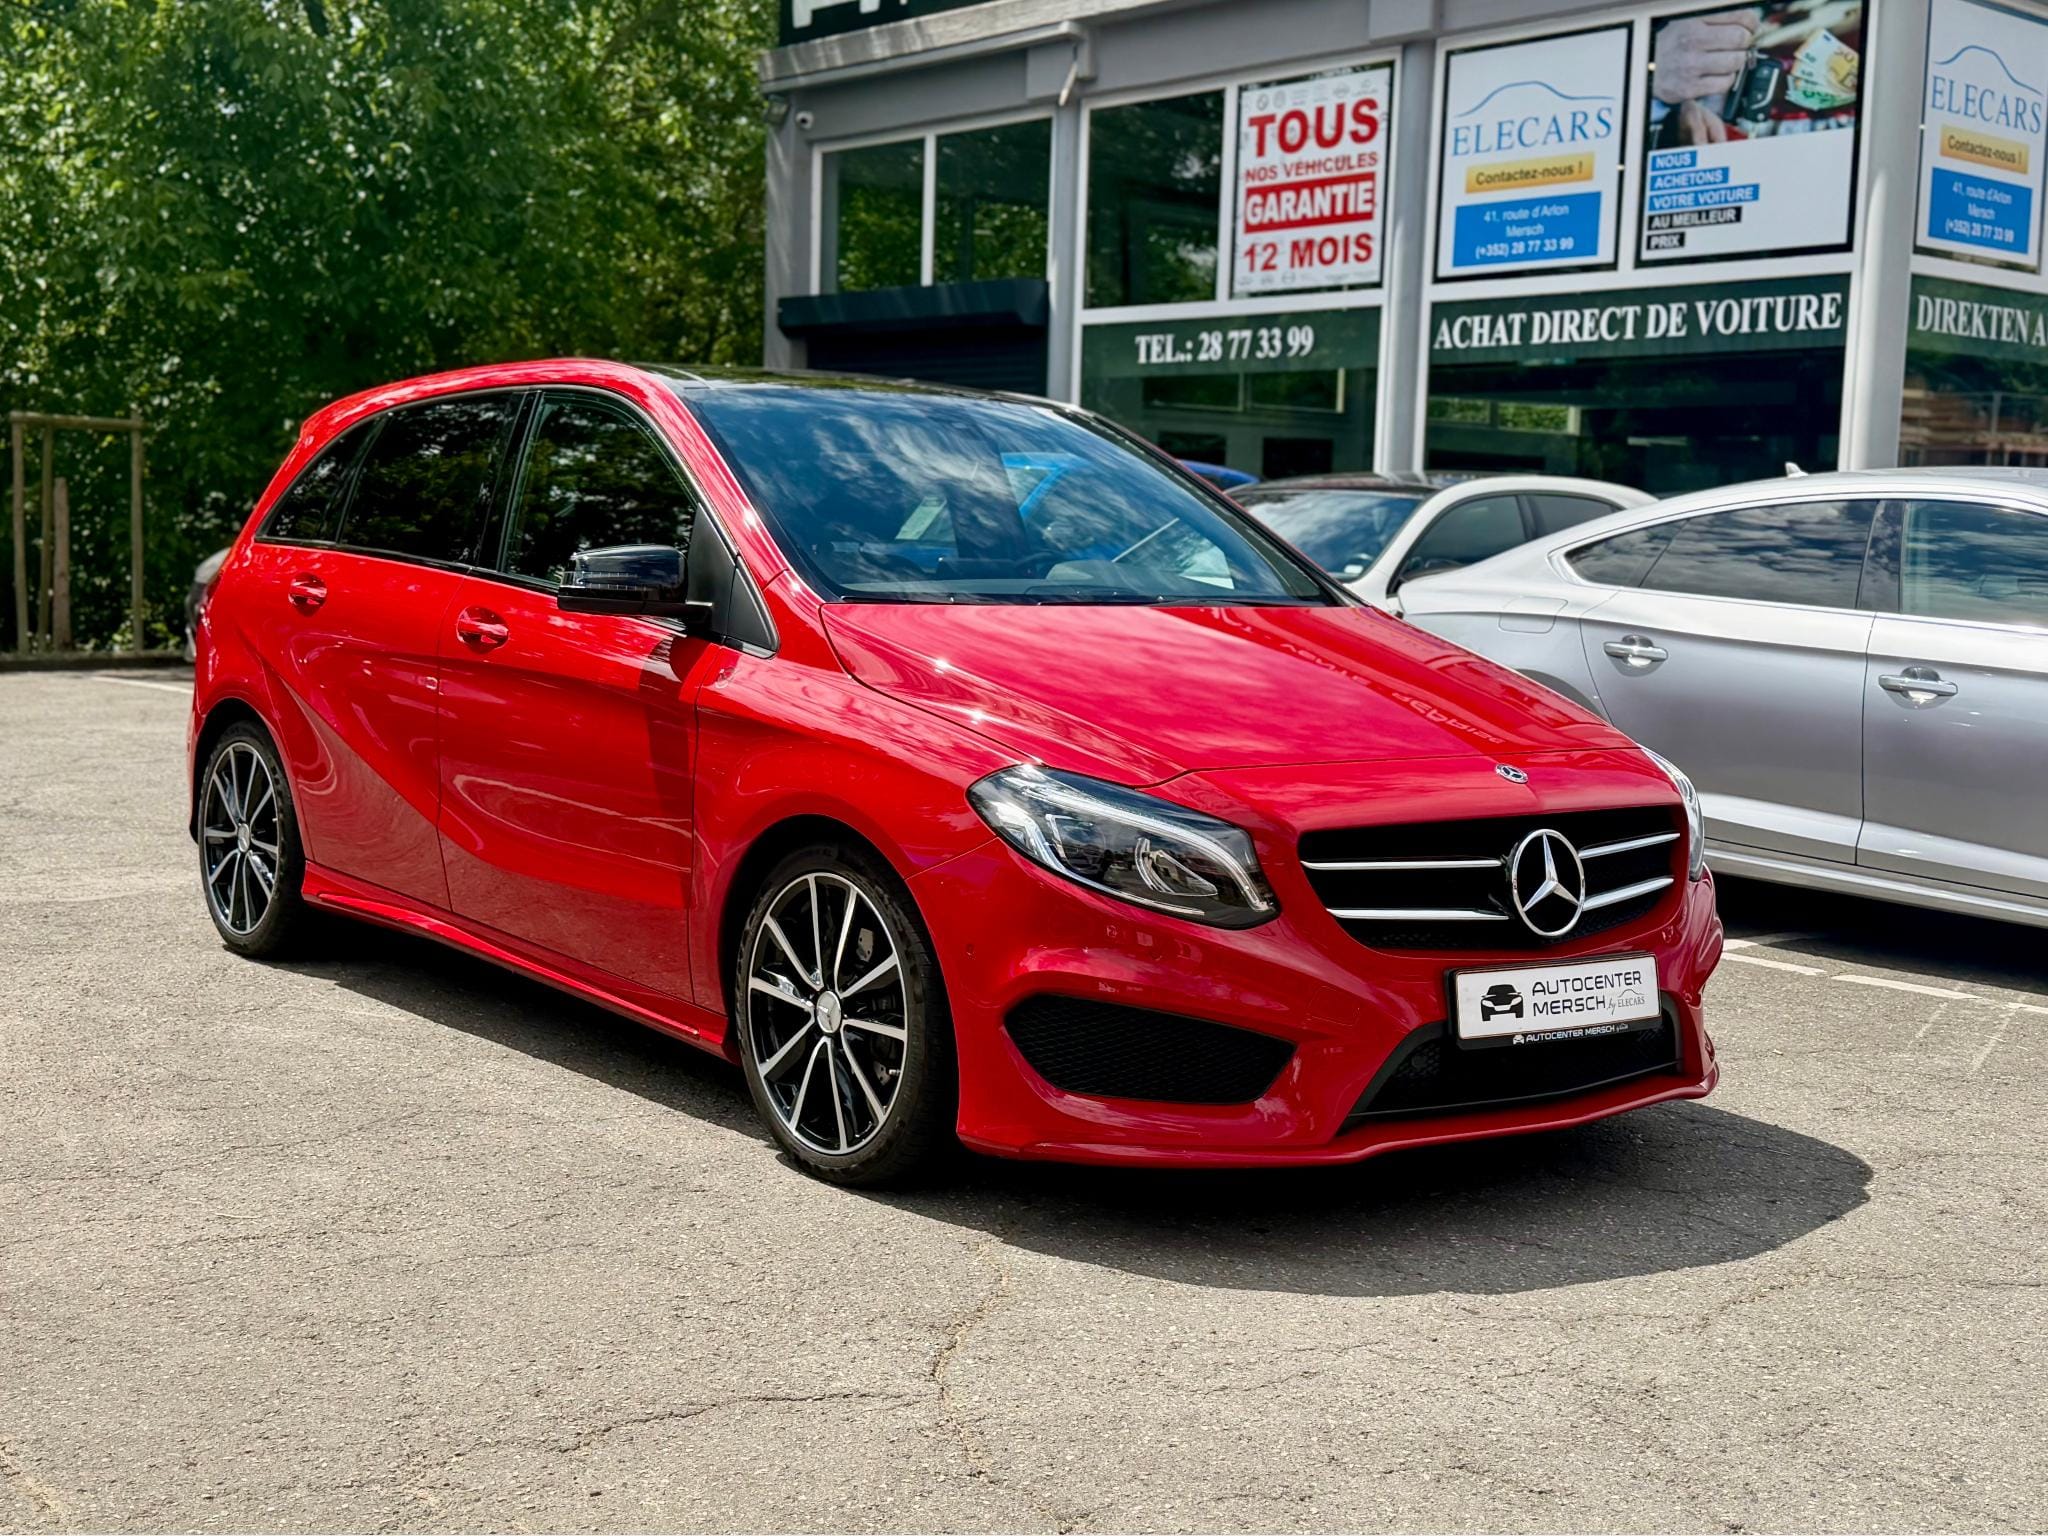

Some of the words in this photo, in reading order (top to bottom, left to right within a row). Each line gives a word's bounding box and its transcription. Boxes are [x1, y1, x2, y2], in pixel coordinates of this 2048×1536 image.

[1931, 75, 2042, 135] ELECARS
[1248, 98, 1379, 158] TOUS
[1452, 107, 1613, 157] ELECARS
[1655, 153, 1691, 168] NOUS
[1245, 164, 1278, 183] NOS
[1475, 164, 1574, 186] Contactez-nous
[1654, 169, 1723, 189] ACHETONS
[1246, 179, 1375, 226] GARANTIE
[1653, 192, 1696, 209] VOTRE
[1697, 186, 1755, 204] VOITURE
[1650, 215, 1671, 230] AU
[1672, 207, 1737, 227] MEILLEUR
[1243, 242, 1277, 273] 12
[1290, 233, 1373, 269] MOIS
[1649, 234, 1681, 249] PRIX
[1433, 312, 1526, 350] ACHAT
[1531, 306, 1640, 345] DIRECT
[1645, 303, 1687, 339] DE
[1696, 292, 1842, 336] VOITURE
[1916, 294, 2031, 344] DIREKTEN
[1197, 331, 1223, 362] 28
[1227, 329, 1253, 360] 77
[1256, 327, 1282, 359] 33
[1287, 325, 1314, 357] 99
[1532, 970, 1642, 997] AUTOCENTER
[1533, 995, 1606, 1017] MERSCH
[1617, 996, 1646, 1008] ELECARS
[1526, 1029, 1584, 1043] AUTOCENTER
[1584, 1024, 1615, 1037] MERSCH
